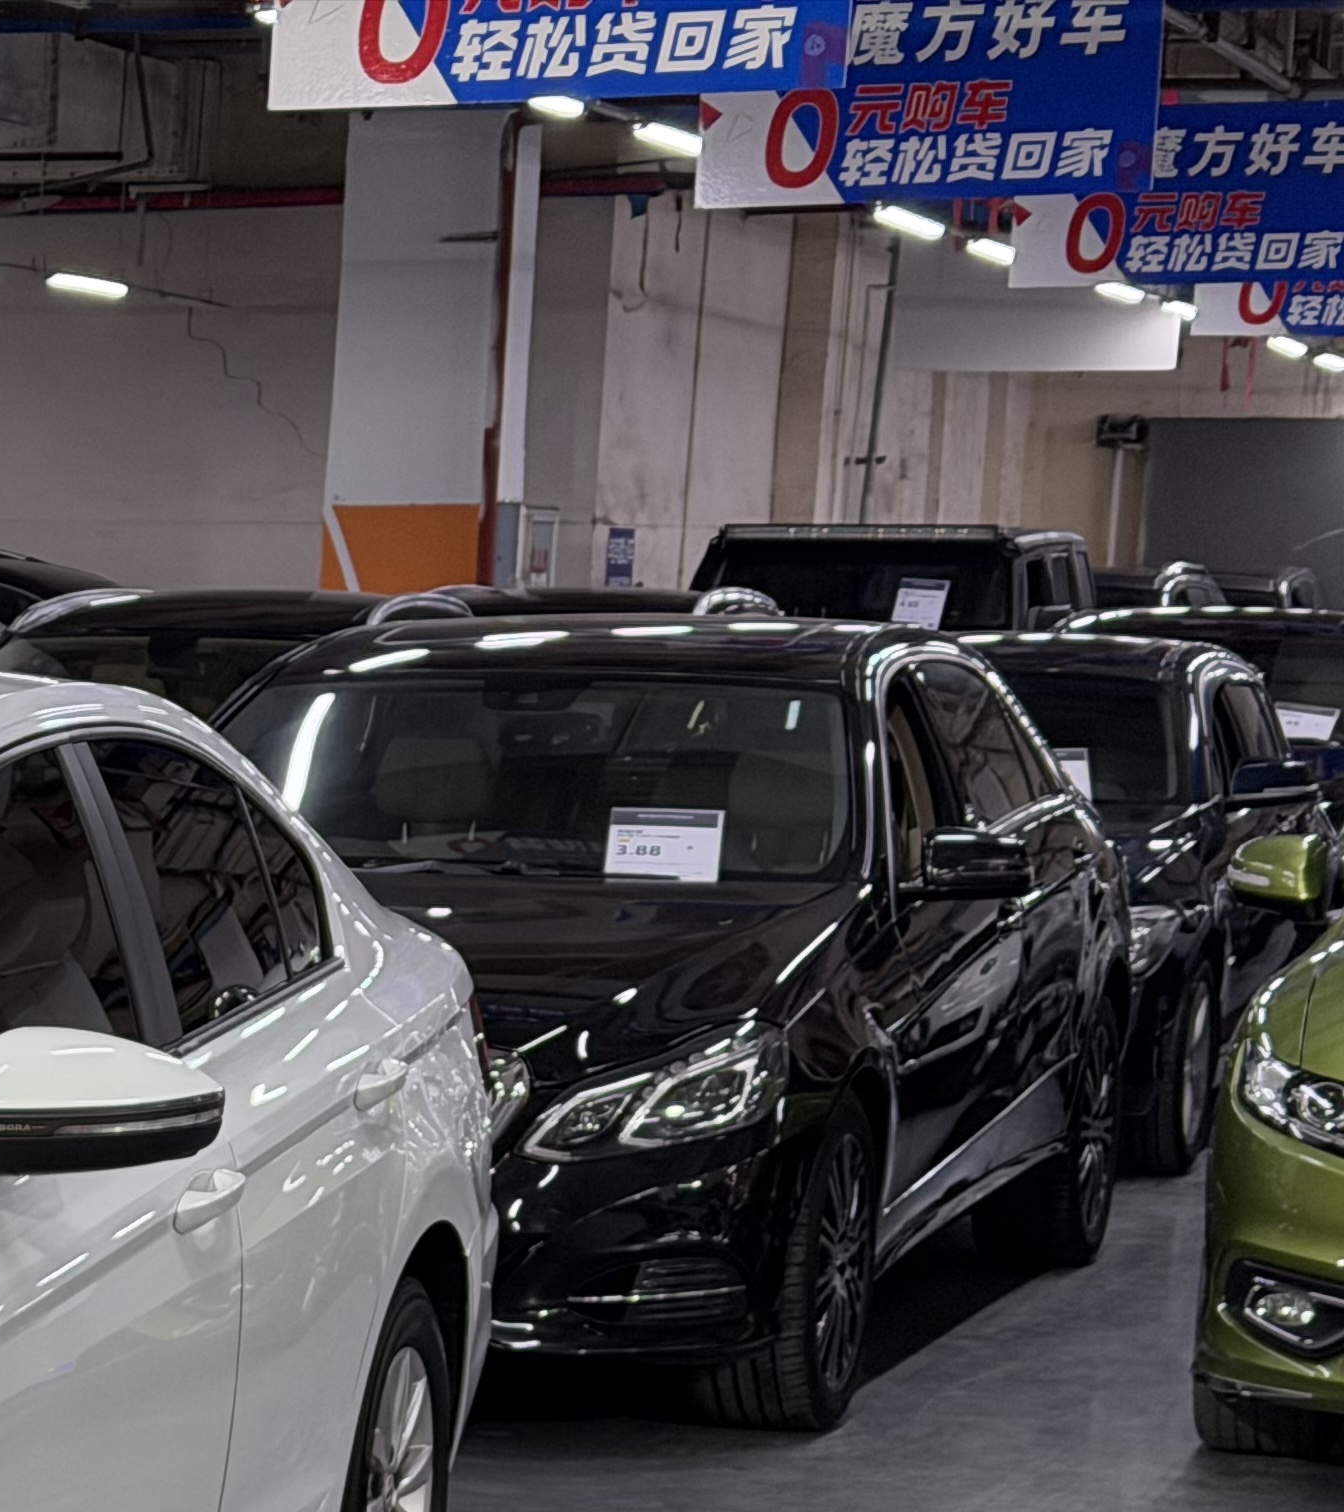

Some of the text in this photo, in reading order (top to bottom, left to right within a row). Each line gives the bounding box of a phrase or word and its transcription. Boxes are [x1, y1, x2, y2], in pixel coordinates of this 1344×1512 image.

[450, 4, 796, 83] 轻松贷回家
[848, 0, 1129, 66] 魔方好车
[839, 128, 1114, 187] 轻松贷回家
